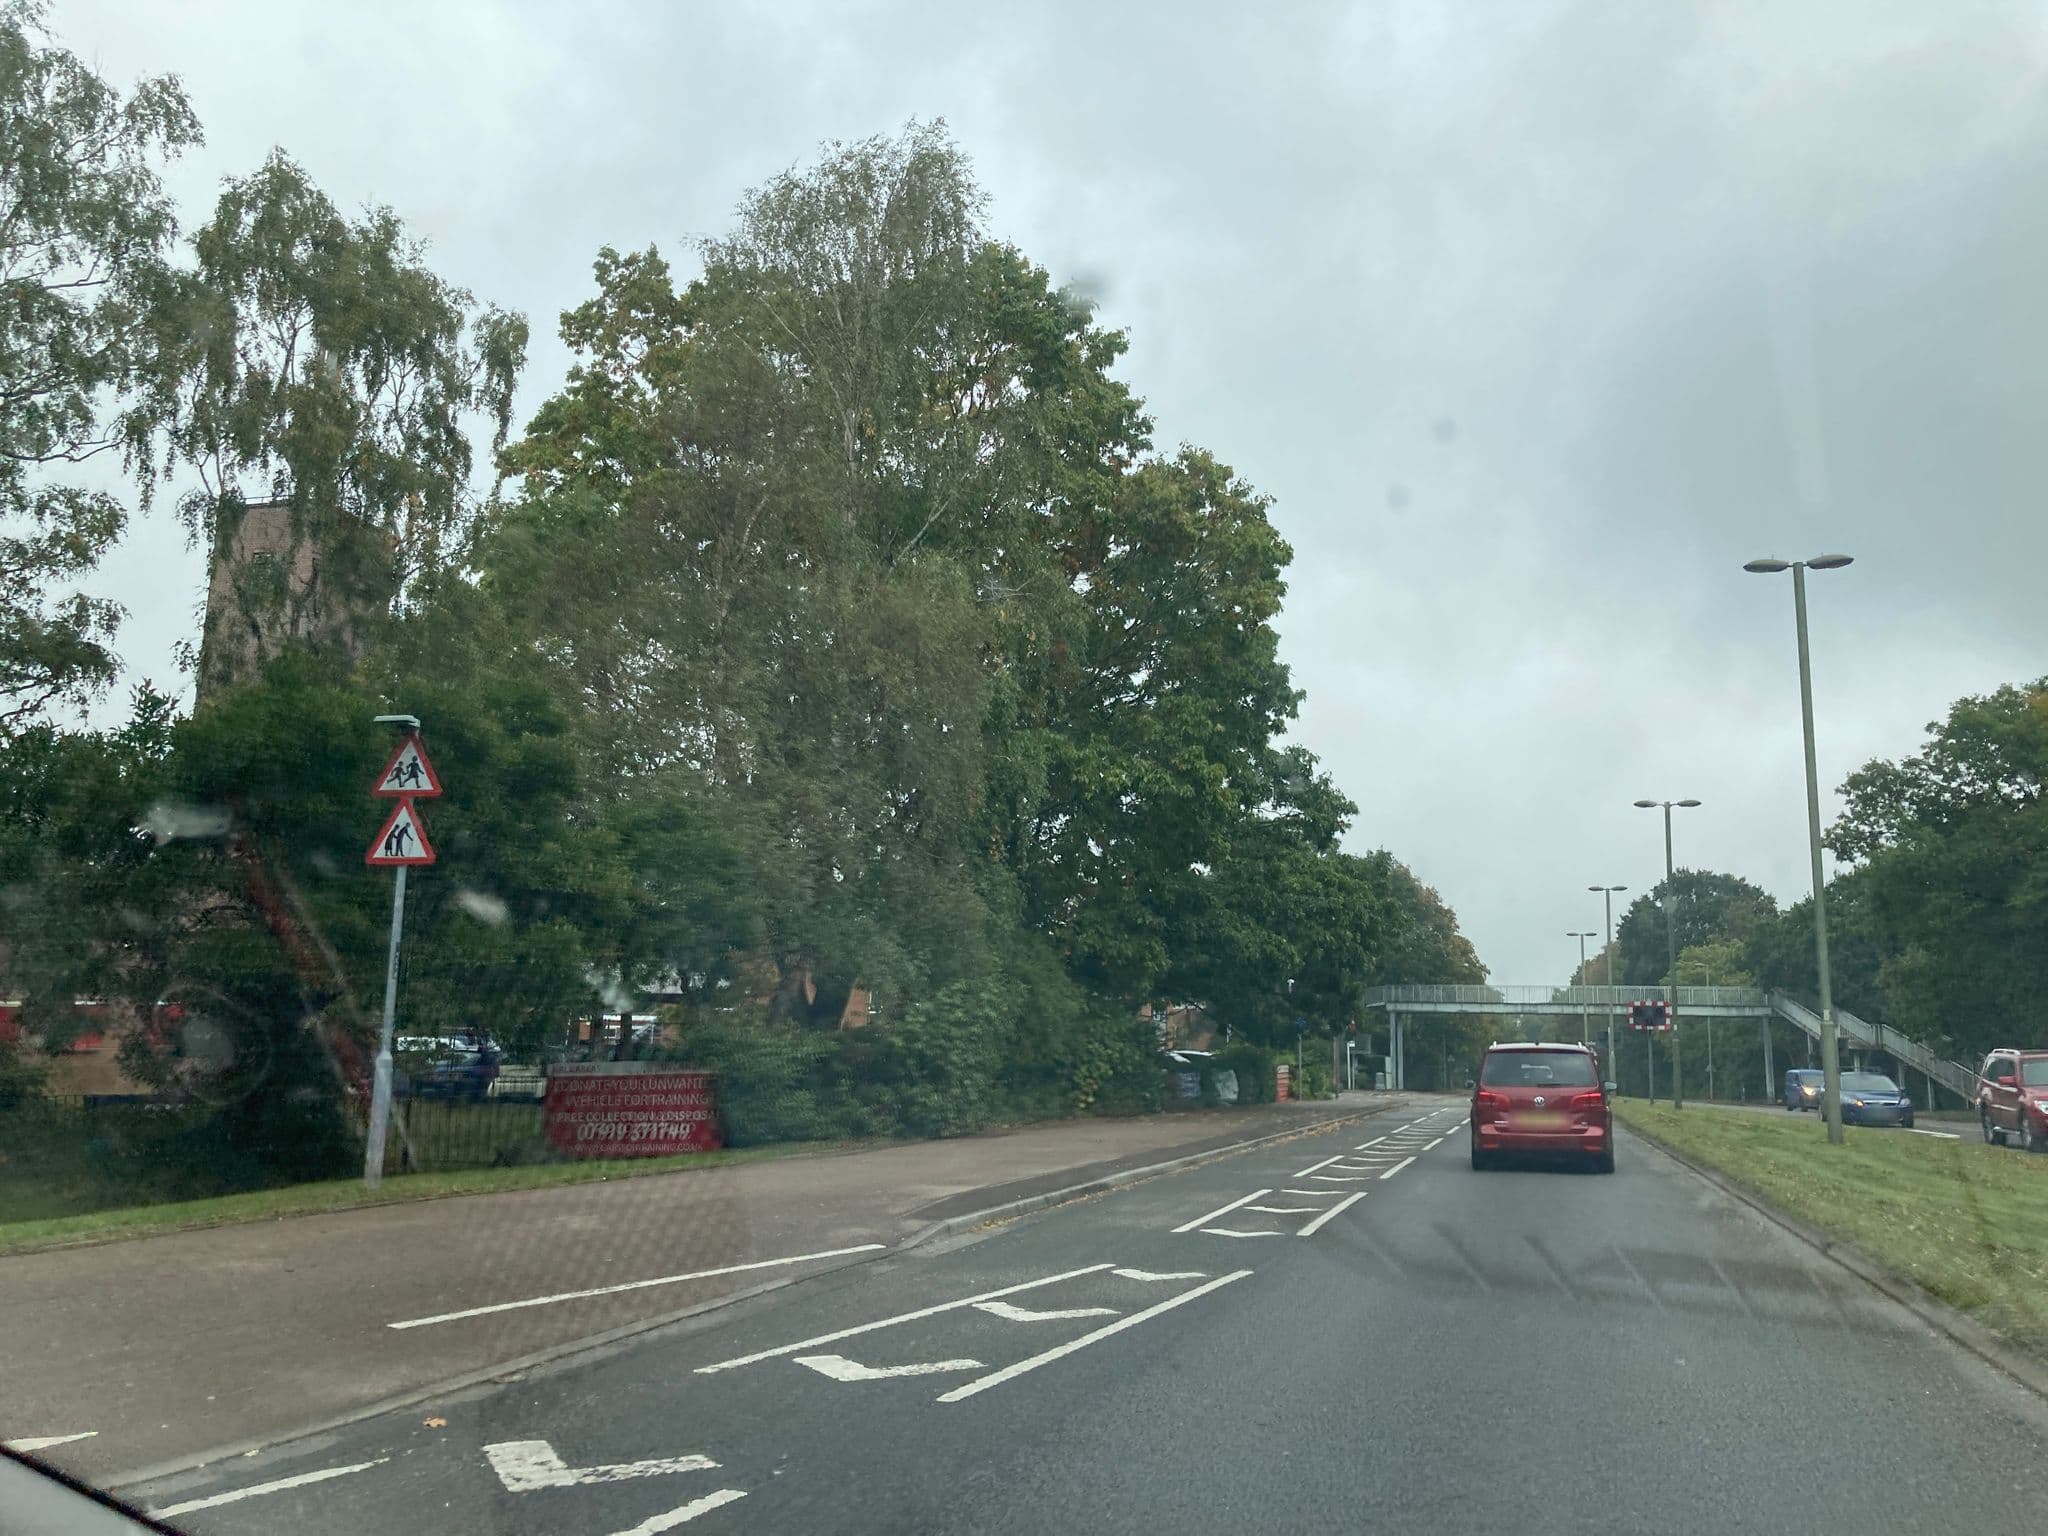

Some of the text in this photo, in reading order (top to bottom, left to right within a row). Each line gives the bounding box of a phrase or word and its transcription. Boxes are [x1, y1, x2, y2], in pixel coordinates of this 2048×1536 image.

[558, 1079, 611, 1092] DONATE
[613, 1078, 646, 1091] YOUR
[571, 1093, 710, 1107] VEHICLE FOR TRAINING
[556, 1111, 586, 1122] FREE
[586, 1110, 655, 1122] COLLECTION
